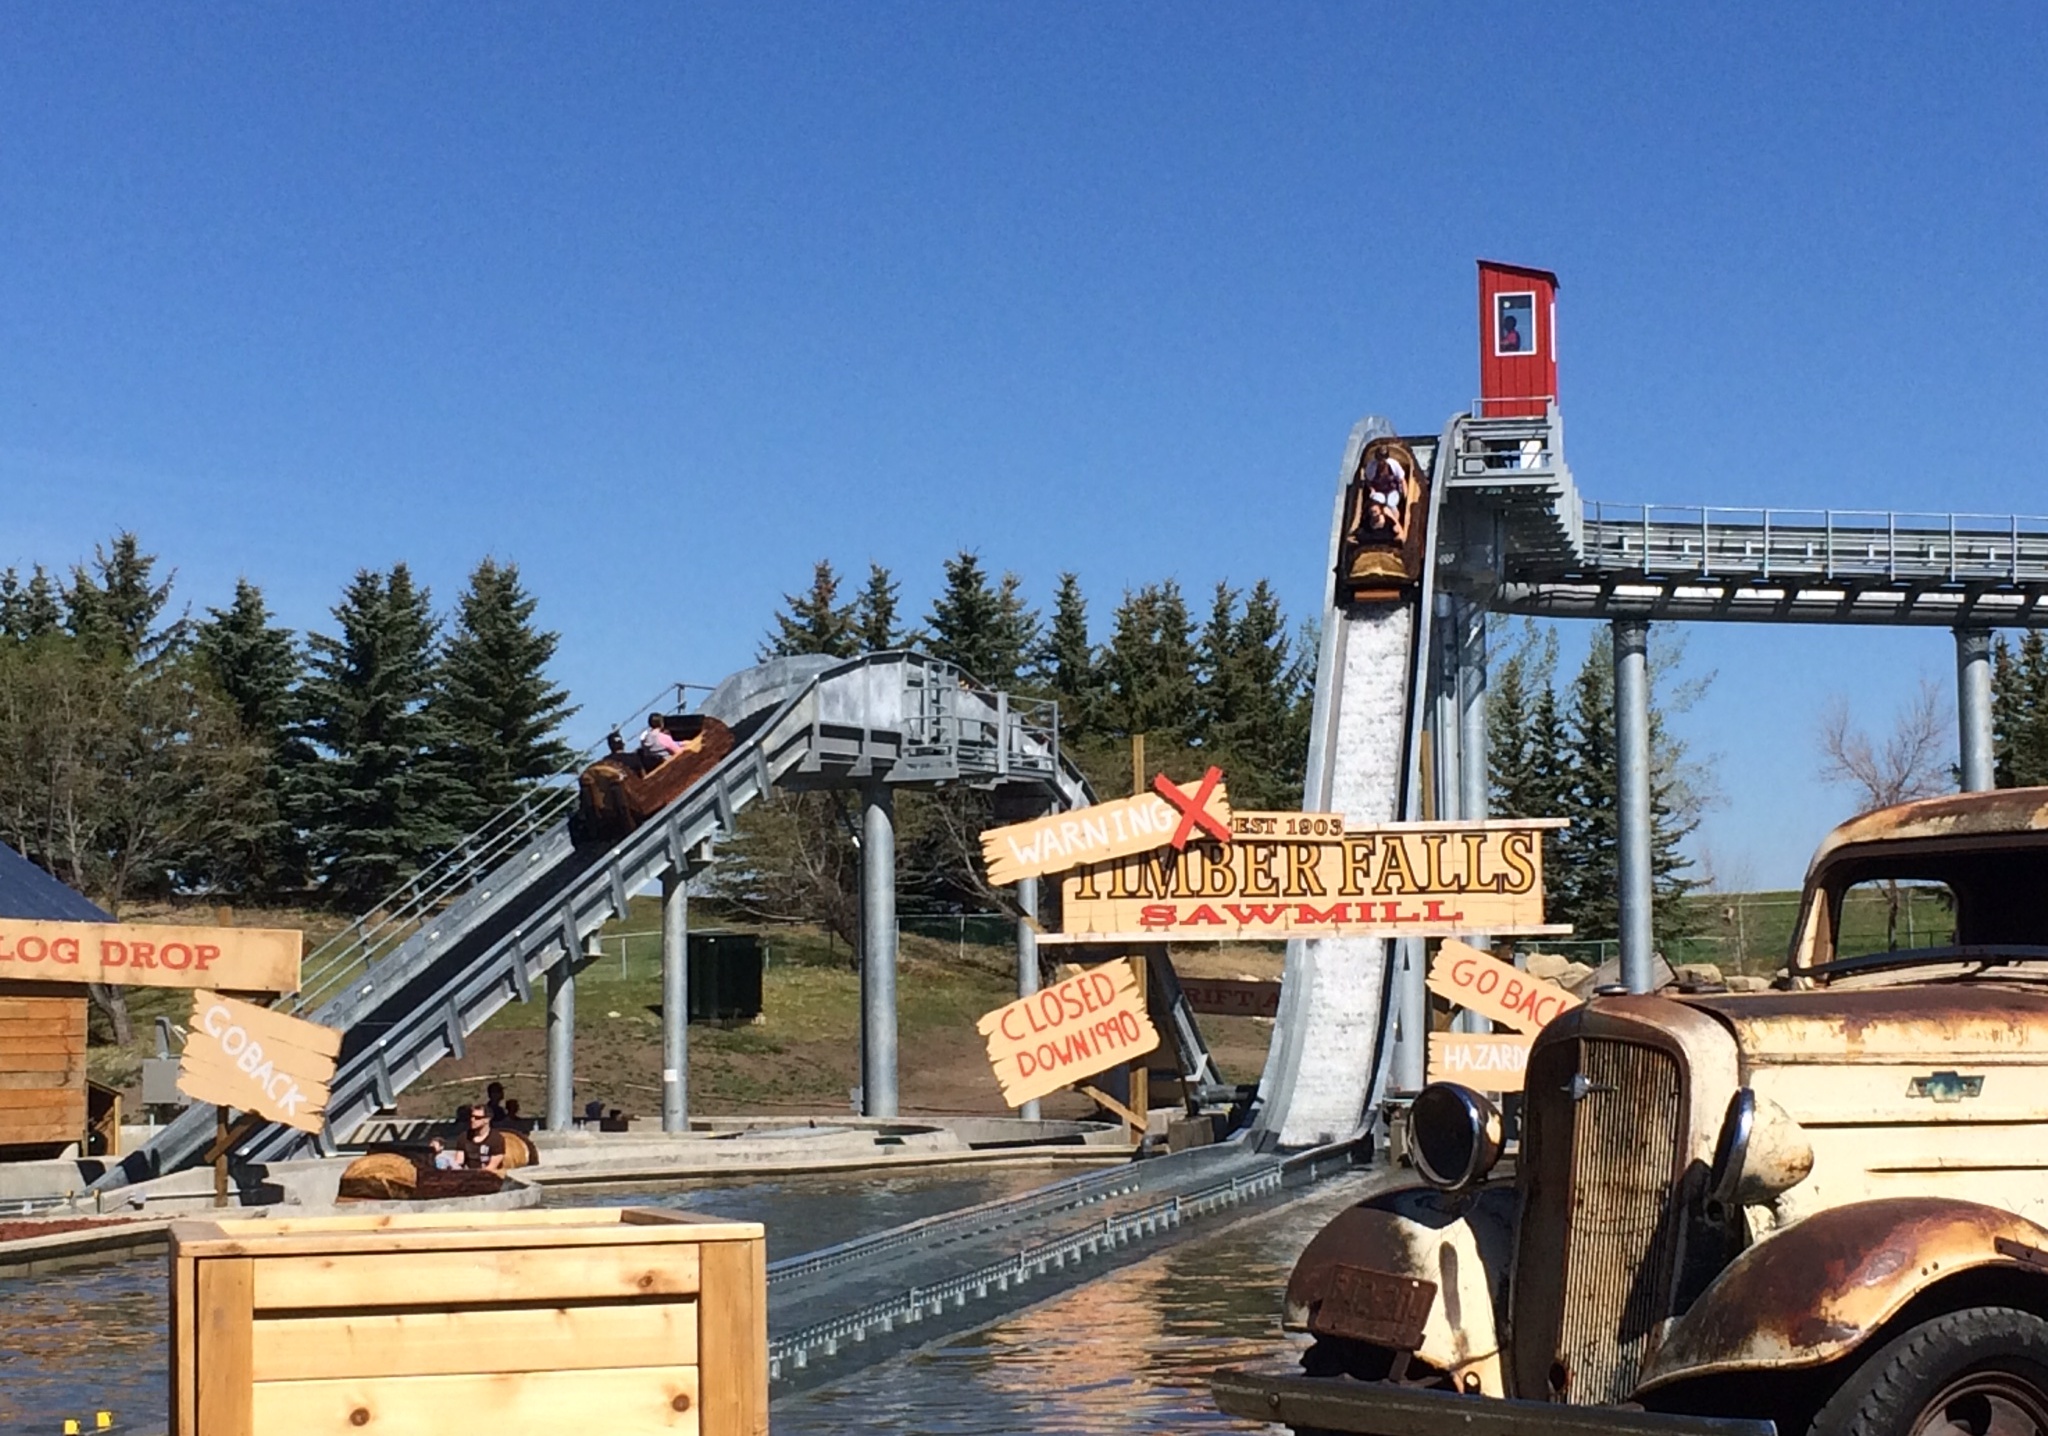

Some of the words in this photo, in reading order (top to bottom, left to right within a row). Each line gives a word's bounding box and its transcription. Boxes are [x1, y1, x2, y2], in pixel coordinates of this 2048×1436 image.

[1007, 799, 1176, 866] WARNING
[1234, 817, 1277, 835] EST
[1286, 818, 1344, 837] 1903
[1338, 832, 1536, 896] FALLS
[1140, 900, 1464, 926] SAWMILL
[100, 940, 221, 971] DROP
[1451, 959, 1500, 995] GO
[1001, 972, 1116, 1041] CLOSED
